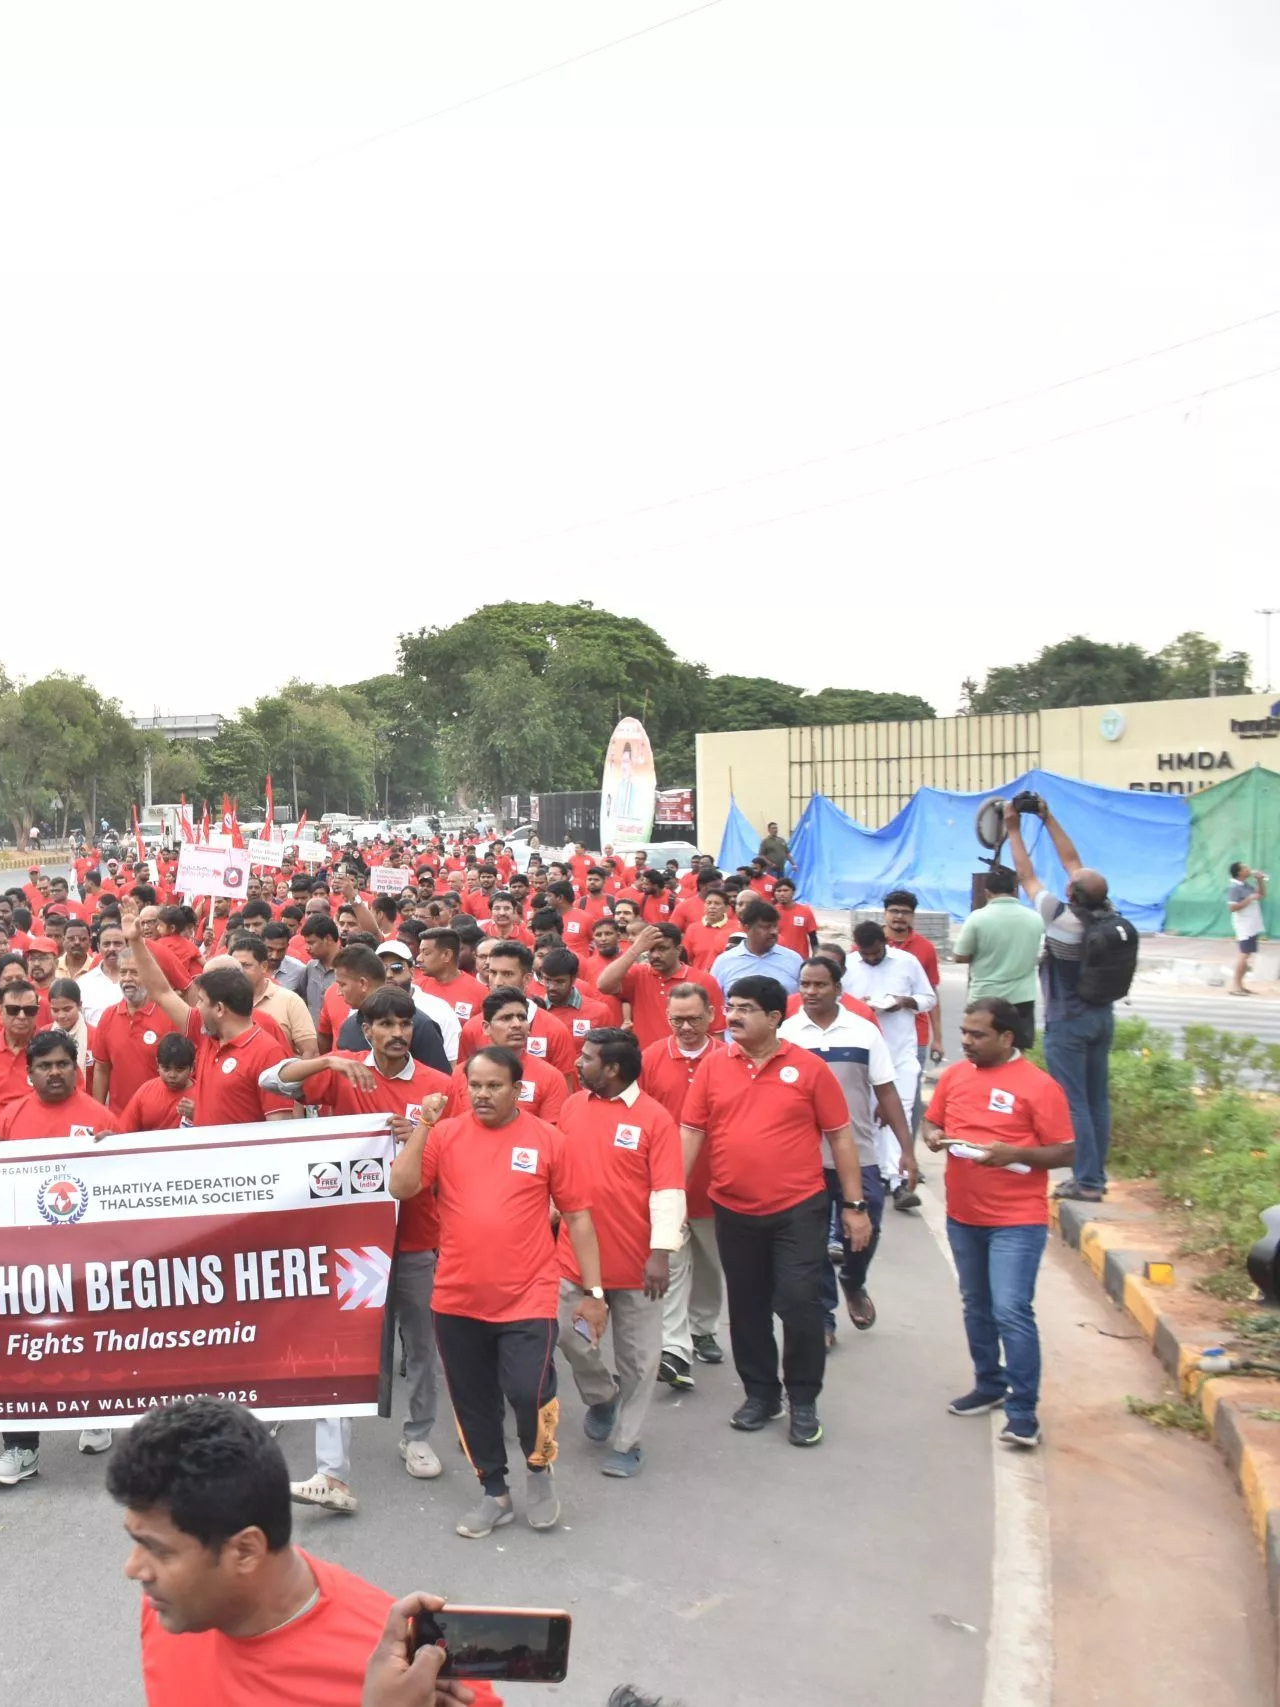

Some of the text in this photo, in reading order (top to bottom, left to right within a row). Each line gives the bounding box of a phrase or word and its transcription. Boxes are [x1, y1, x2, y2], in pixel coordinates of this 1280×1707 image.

[1157, 751, 1234, 771] HMDA
[55, 1163, 67, 1172] BY
[92, 1174, 280, 1197] BHARTIYA FEDERATION OF
[100, 1189, 274, 1210] THALASSEMIA SOCIETIES
[85, 1254, 224, 1312] BEGINS
[234, 1245, 330, 1302] HERE
[7, 1330, 84, 1361] Fights
[93, 1321, 256, 1353] Thalassemia
[56, 1400, 90, 1412] DAY
[218, 1390, 258, 1402] 2026
